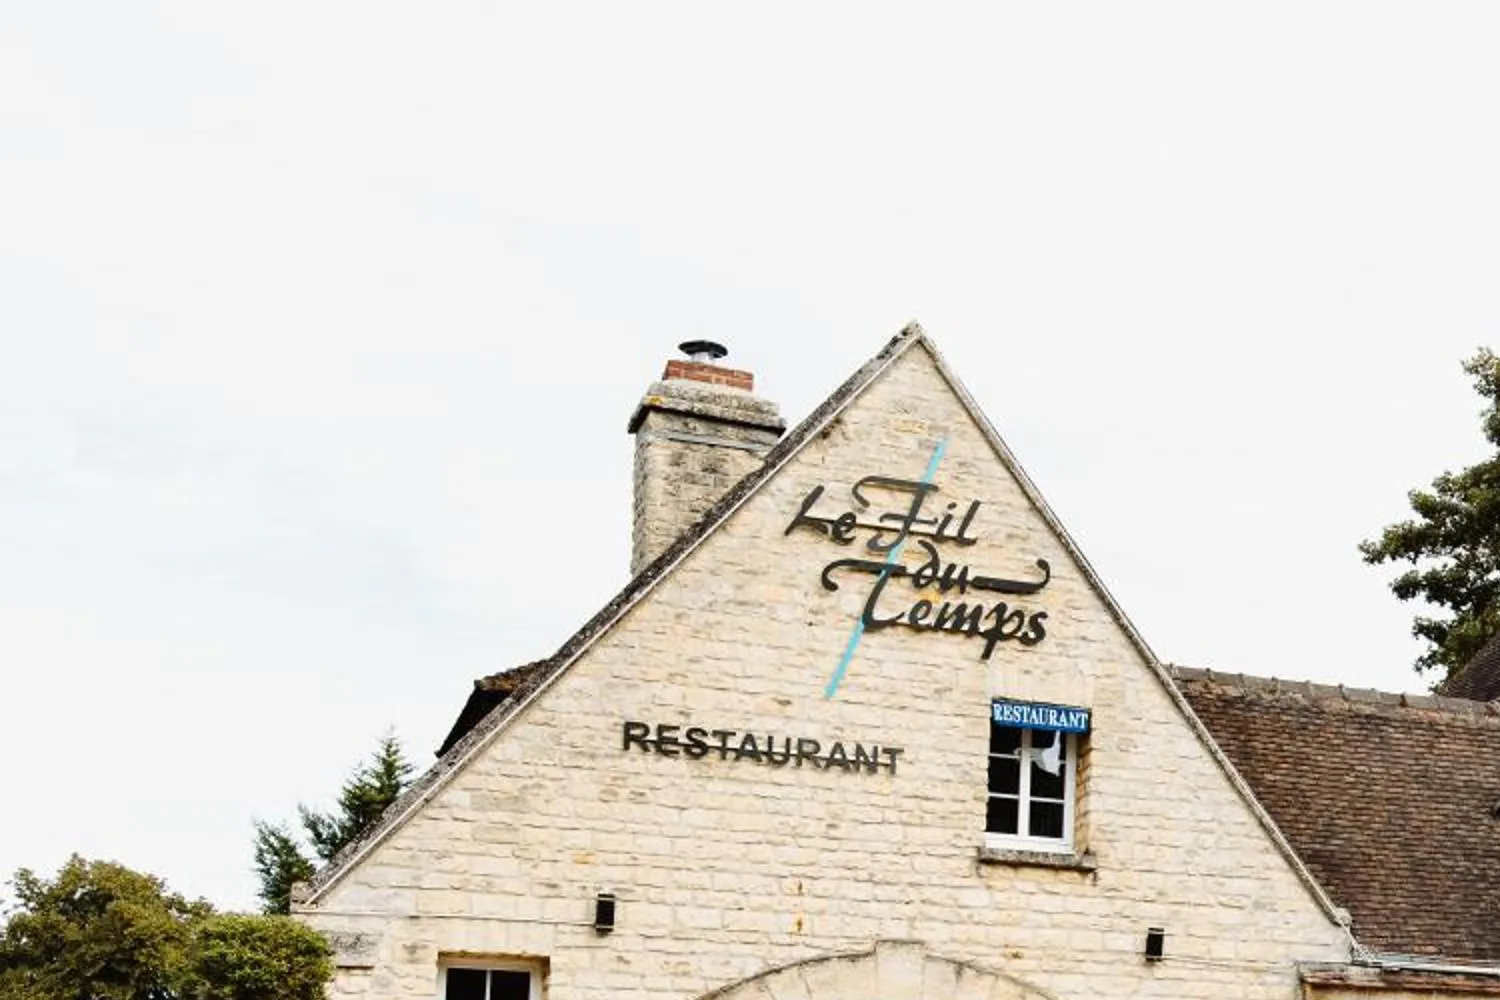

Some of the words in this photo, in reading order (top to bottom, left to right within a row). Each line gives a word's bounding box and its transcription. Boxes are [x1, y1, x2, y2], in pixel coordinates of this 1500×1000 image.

[784, 485, 856, 546] Le
[852, 475, 981, 551] Fil
[821, 558, 1049, 660] Temps
[622, 720, 905, 776] RESTAURANT
[991, 703, 1090, 729] RESTAURANT
